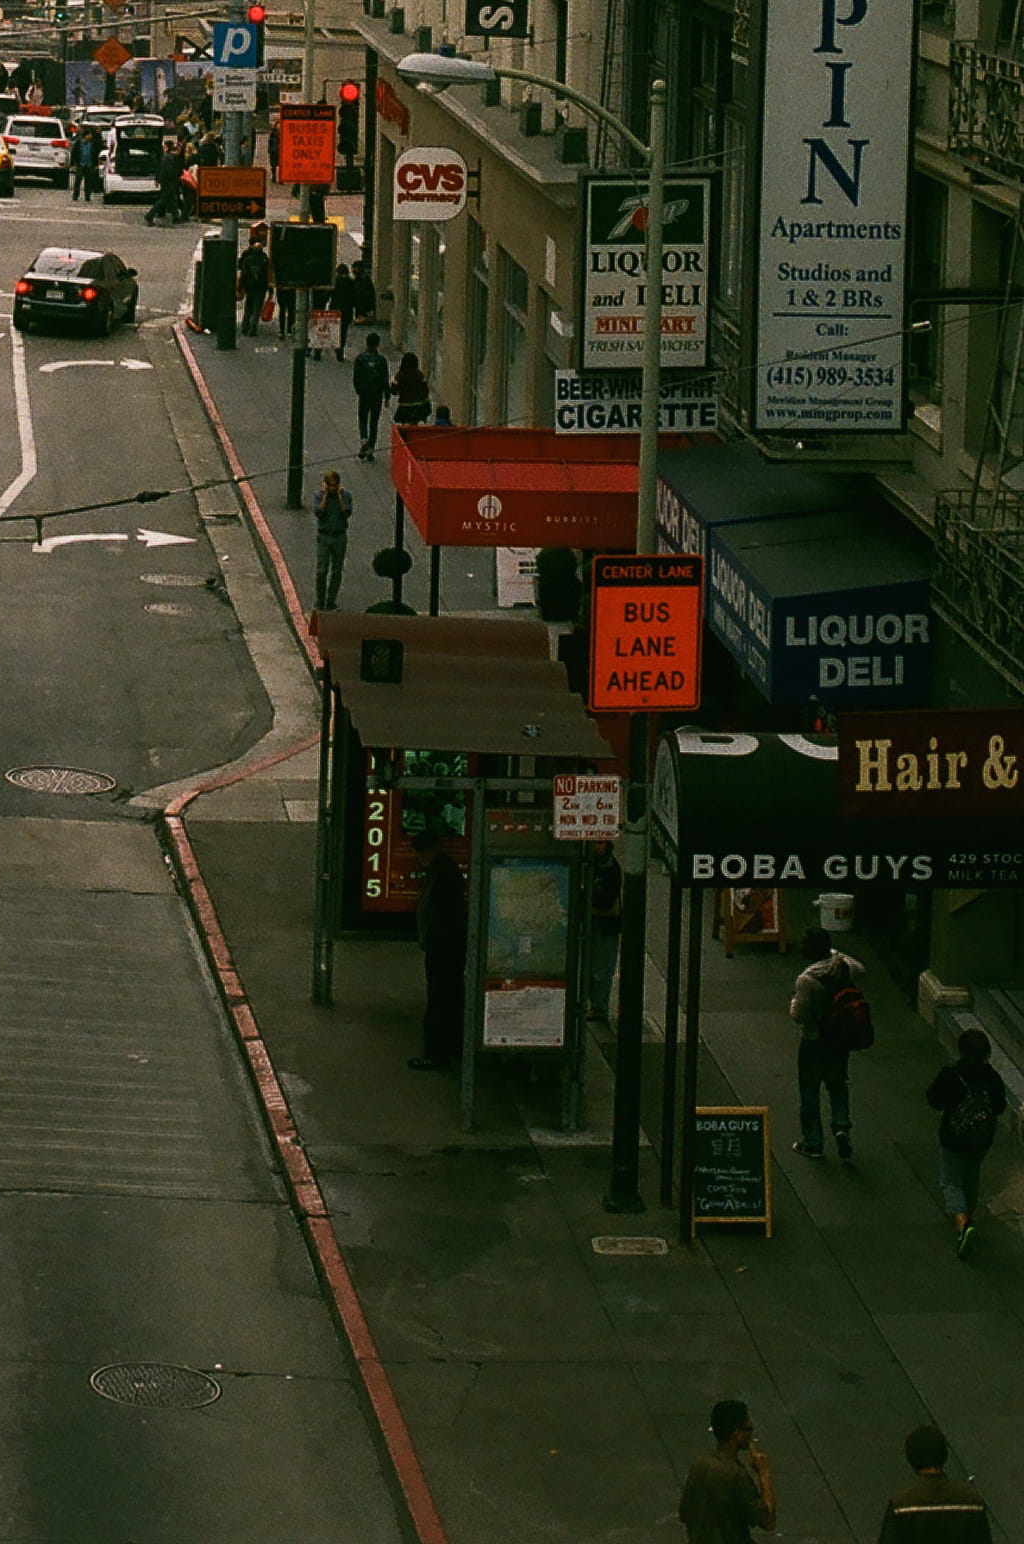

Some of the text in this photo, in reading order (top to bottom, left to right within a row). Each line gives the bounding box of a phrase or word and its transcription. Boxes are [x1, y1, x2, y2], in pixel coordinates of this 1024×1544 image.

[288, 122, 328, 134] BUSES
[292, 135, 325, 147] TAXIS
[292, 148, 322, 160] ONLY
[397, 163, 465, 192] CVS
[398, 189, 461, 205] pharmacy
[201, 201, 244, 213] DETOUR
[771, 216, 902, 244] Apartments
[777, 262, 892, 282] Studios and
[592, 292, 624, 306] and
[788, 289, 883, 307] 1 & 2 BRs
[595, 317, 643, 331] MINI
[816, 323, 849, 337] Call:
[766, 366, 894, 388] (415) 989-3534
[462, 521, 518, 533] MYSTIC
[602, 565, 694, 579] CENTER LANE
[711, 547, 746, 622] LIQUOR
[749, 589, 772, 650] DELI
[624, 603, 670, 622] BUS
[785, 614, 930, 647] LIQUOR
[615, 637, 676, 657] LANE
[819, 655, 905, 688] DELI
[606, 671, 684, 691] AHEAD
[855, 735, 968, 792] Hair
[982, 734, 1019, 790] &
[556, 778, 618, 793] NO PARKING
[560, 814, 616, 825] MON WED FRI
[365, 801, 385, 898] 2015
[692, 854, 934, 880] BOBA GUYS
[948, 853, 977, 865] 429
[947, 869, 1019, 880] MILK TEA
[696, 1120, 760, 1132] BOBA GUYS
